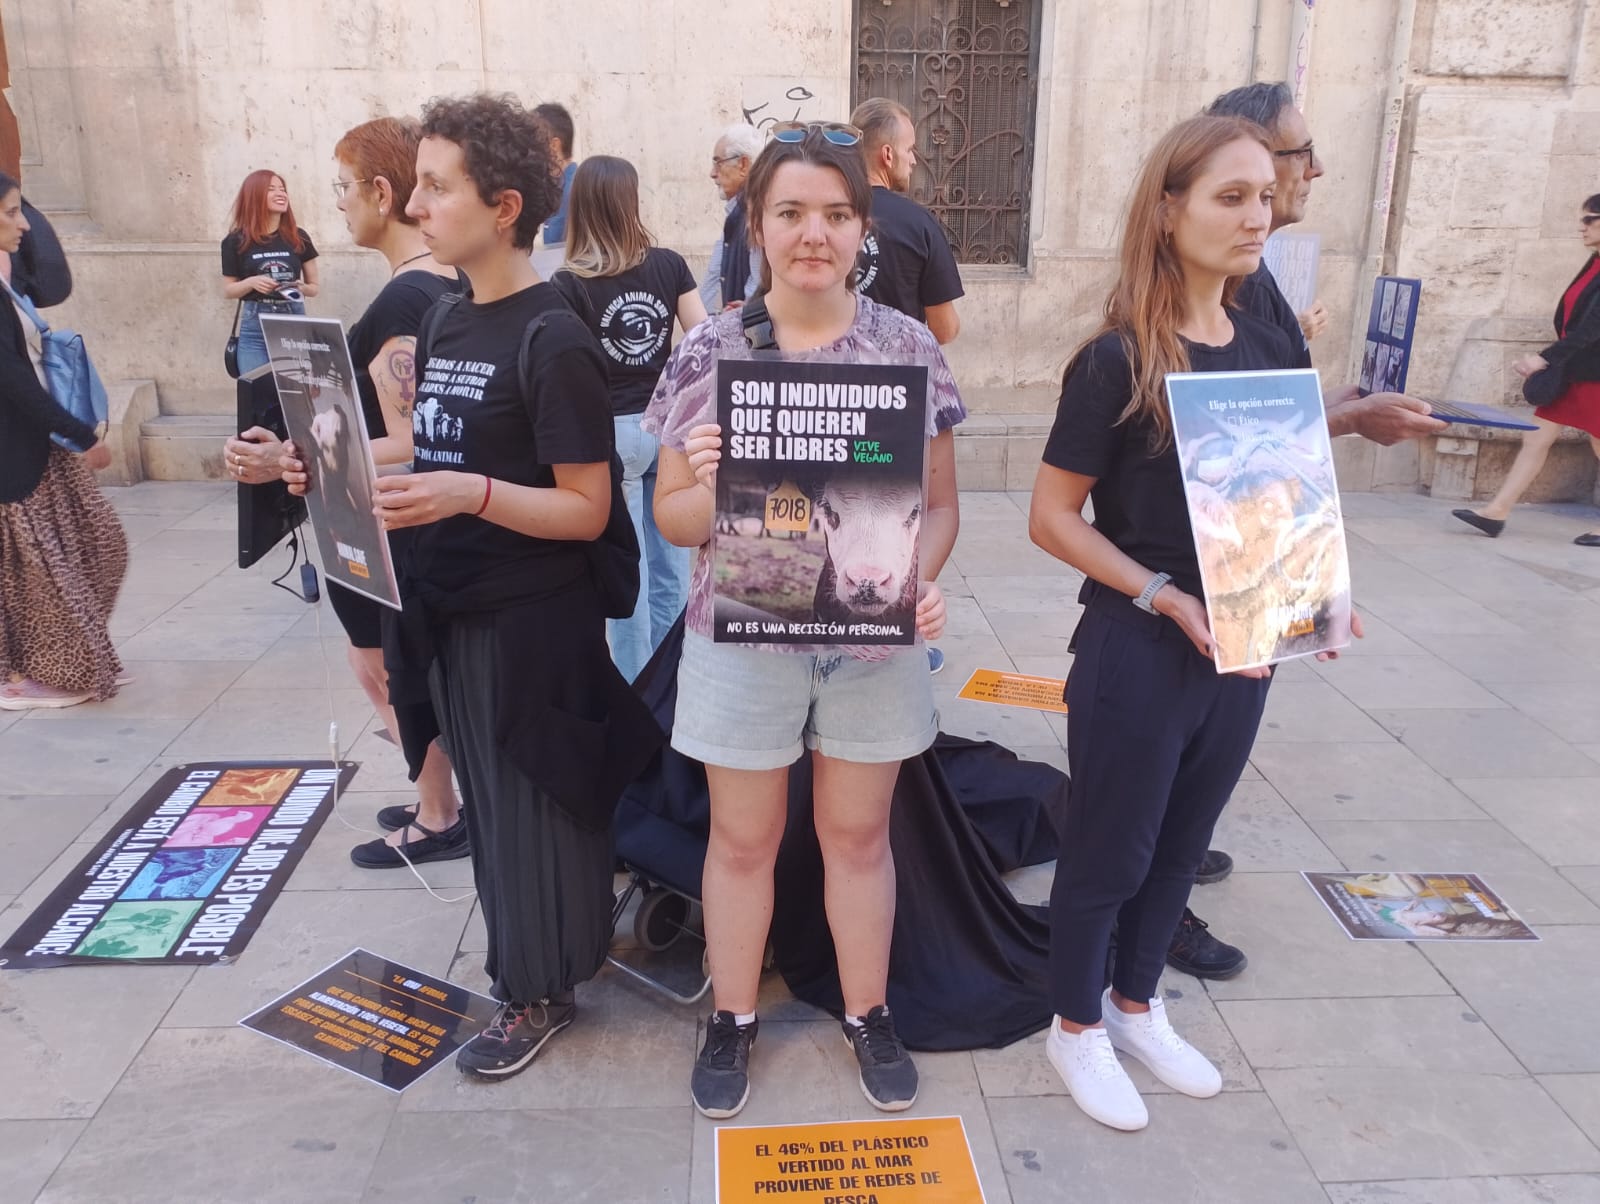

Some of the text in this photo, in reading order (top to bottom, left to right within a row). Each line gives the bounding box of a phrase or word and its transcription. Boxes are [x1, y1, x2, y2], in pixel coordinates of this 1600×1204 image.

[625, 292, 654, 305] ANIMAL
[654, 300, 669, 319] SAVE
[600, 328, 669, 366] ANIMAL SAVE MOVEMENT
[463, 361, 496, 377] NACER
[731, 381, 907, 410] SON INDIVIDUOS
[1228, 399, 1237, 409] la
[1238, 397, 1263, 411] opción
[730, 408, 866, 436] QUE QUIEREN
[730, 435, 848, 462] SER LIBRES
[853, 440, 880, 451] VIVE
[853, 451, 893, 463] VEGANO
[769, 497, 807, 522] 7018
[726, 619, 904, 637] NO ES UNA DECISIÓN PERSONAL
[187, 770, 220, 781] EL
[155, 781, 210, 815] CAMBIO
[130, 817, 180, 840] ESTÁ
[175, 768, 343, 957] UN MUNDO MEJOR ES POSIBLE
[79, 852, 151, 901] NUESTRO
[25, 904, 105, 957] ALCANCE
[378, 1007, 406, 1020] GLOBAL
[378, 1018, 409, 1034] VEGETAL
[407, 1030, 421, 1038] ES
[419, 1034, 440, 1047] VITAL
[420, 1049, 433, 1057] LA
[755, 1135, 929, 1157] EL 46% DEL PLÁSTICO
[778, 1154, 913, 1174] VERTIDO AL MAR
[754, 1171, 942, 1195] PROVIENE DE REDES DE
